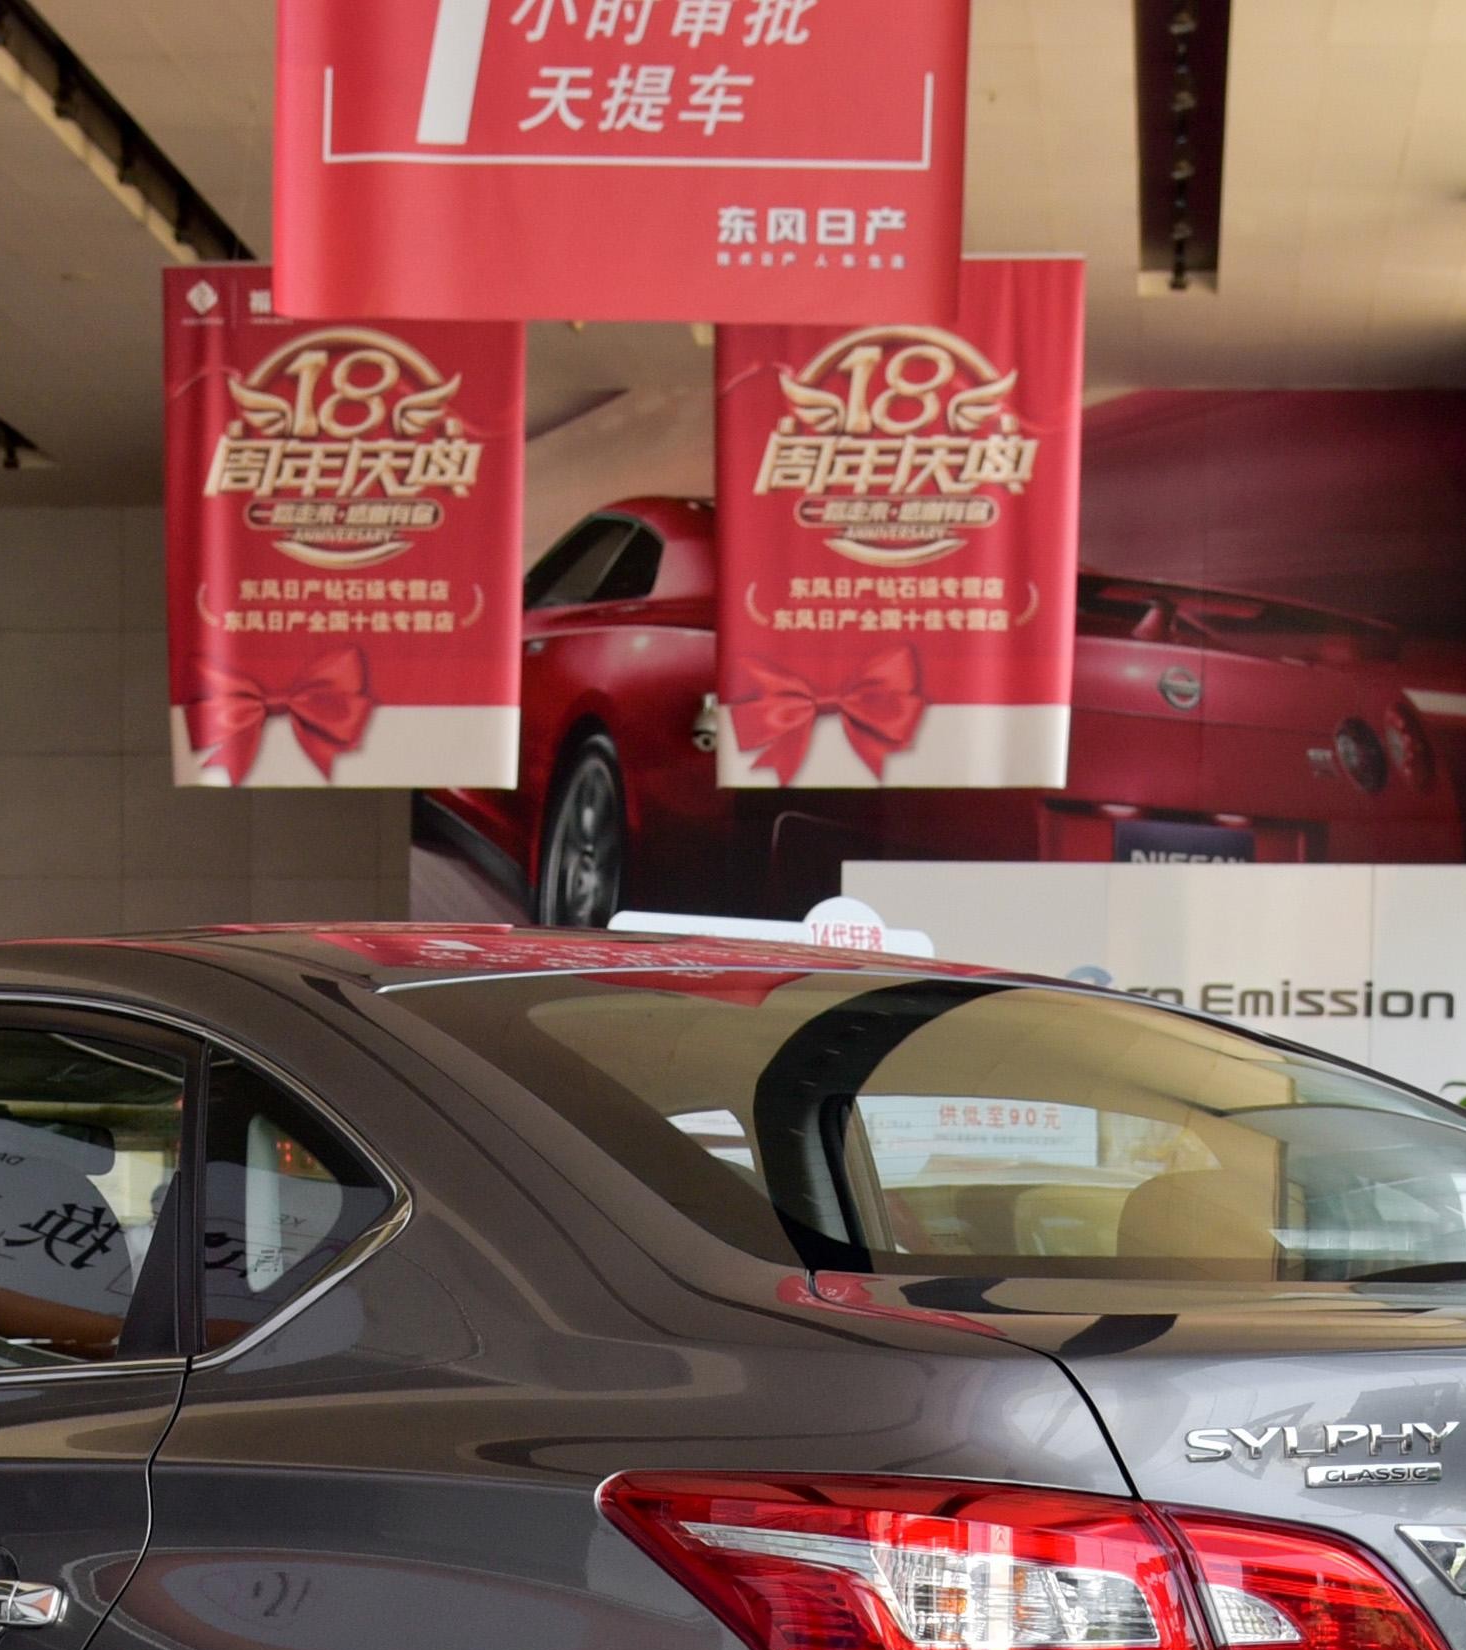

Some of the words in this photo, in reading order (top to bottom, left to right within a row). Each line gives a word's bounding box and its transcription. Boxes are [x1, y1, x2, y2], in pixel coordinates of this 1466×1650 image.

[518, 63, 754, 136] 天提车
[717, 206, 907, 246] 东风日产
[284, 349, 401, 437] 18
[837, 344, 956, 435] 18
[202, 433, 485, 498] 周年庆典
[753, 430, 1041, 497] 周年庆典
[1200, 979, 1455, 1020] Emission
[1185, 1421, 1460, 1464] SYLPHY
[1324, 1466, 1430, 1484] CLASSIC
